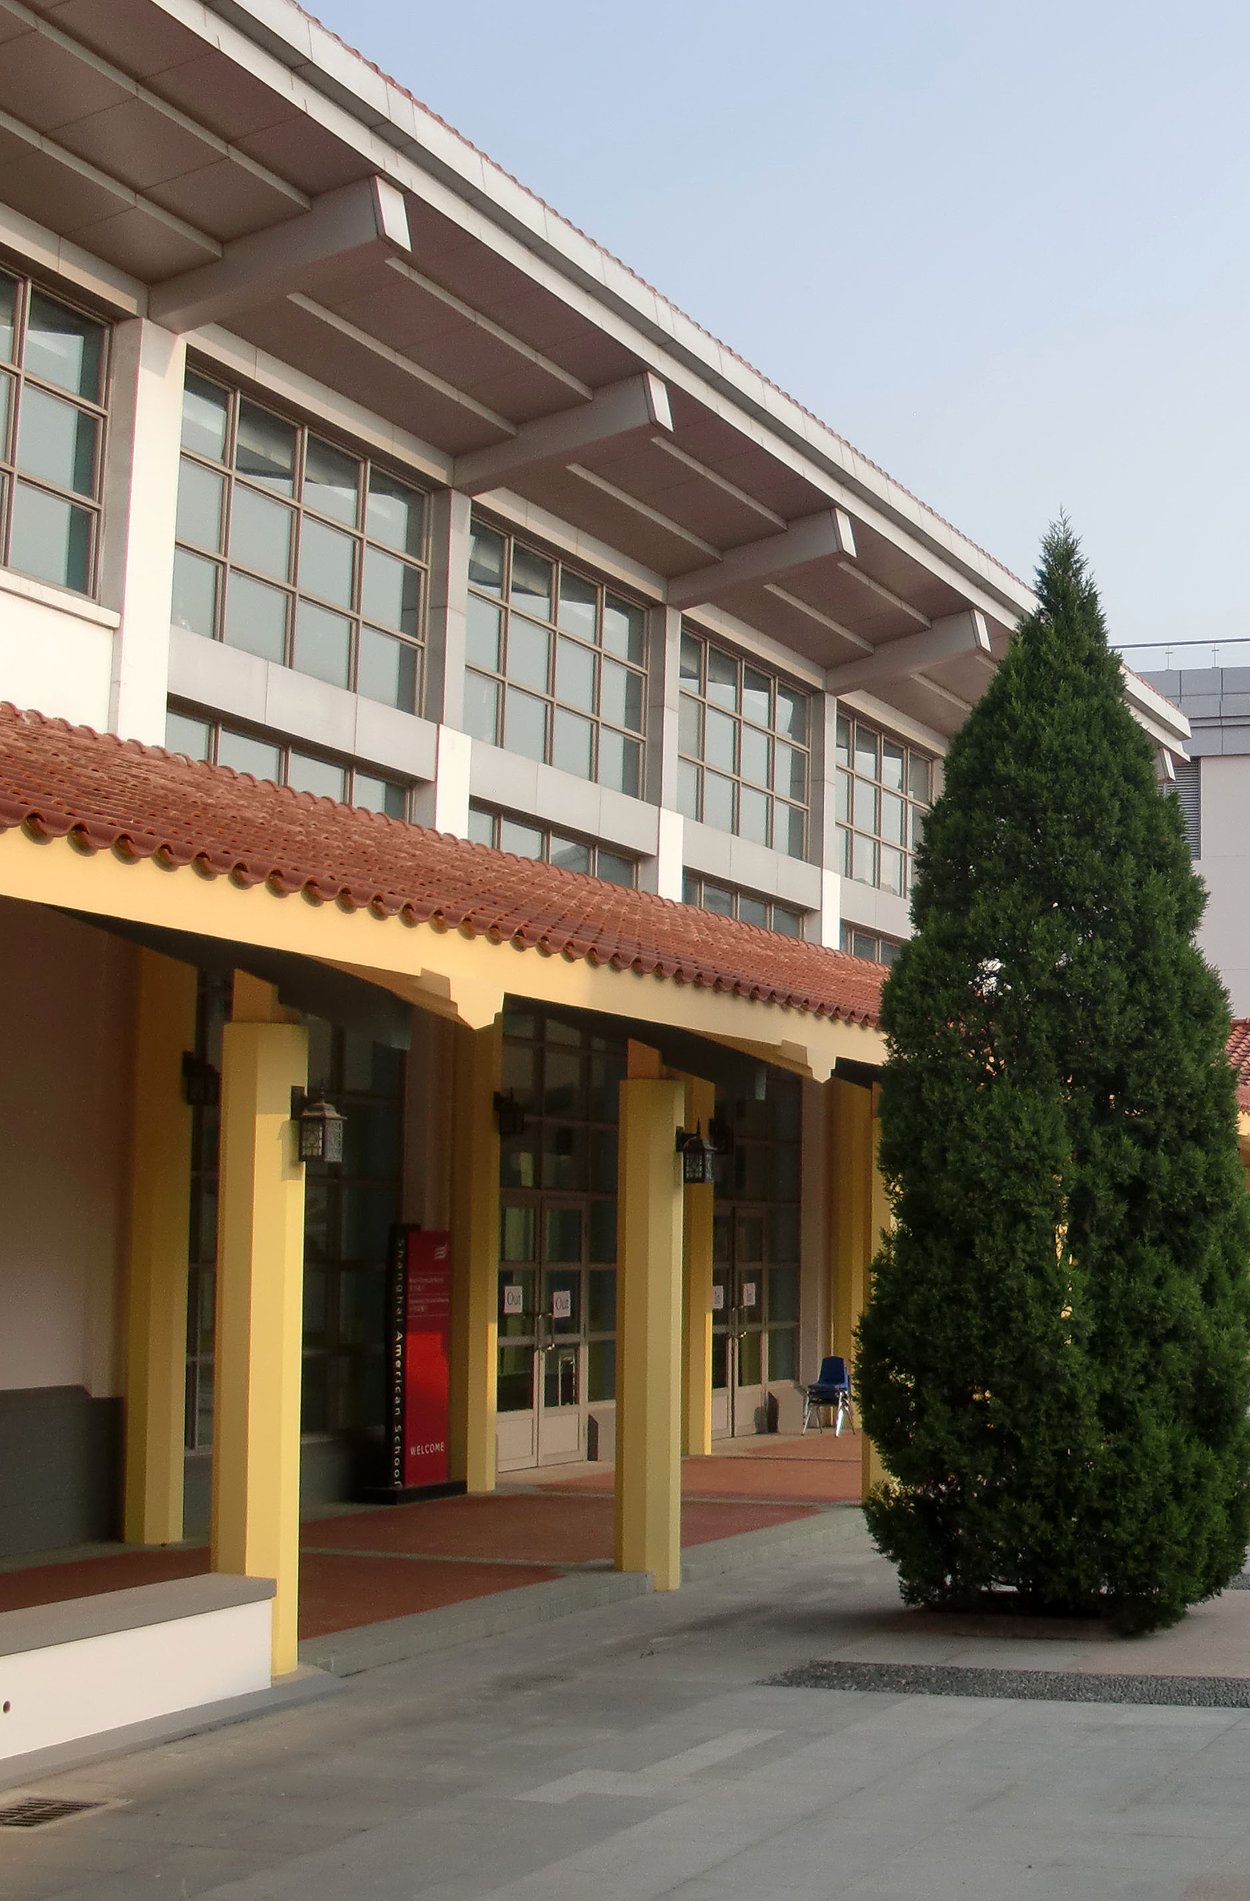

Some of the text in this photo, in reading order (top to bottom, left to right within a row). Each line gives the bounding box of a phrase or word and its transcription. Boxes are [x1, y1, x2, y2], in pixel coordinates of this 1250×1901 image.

[507, 1292, 521, 1305] Out
[556, 1298, 570, 1310] Out
[394, 1239, 404, 1488] Shanghai American School
[410, 1442, 446, 1456] WELCOME
